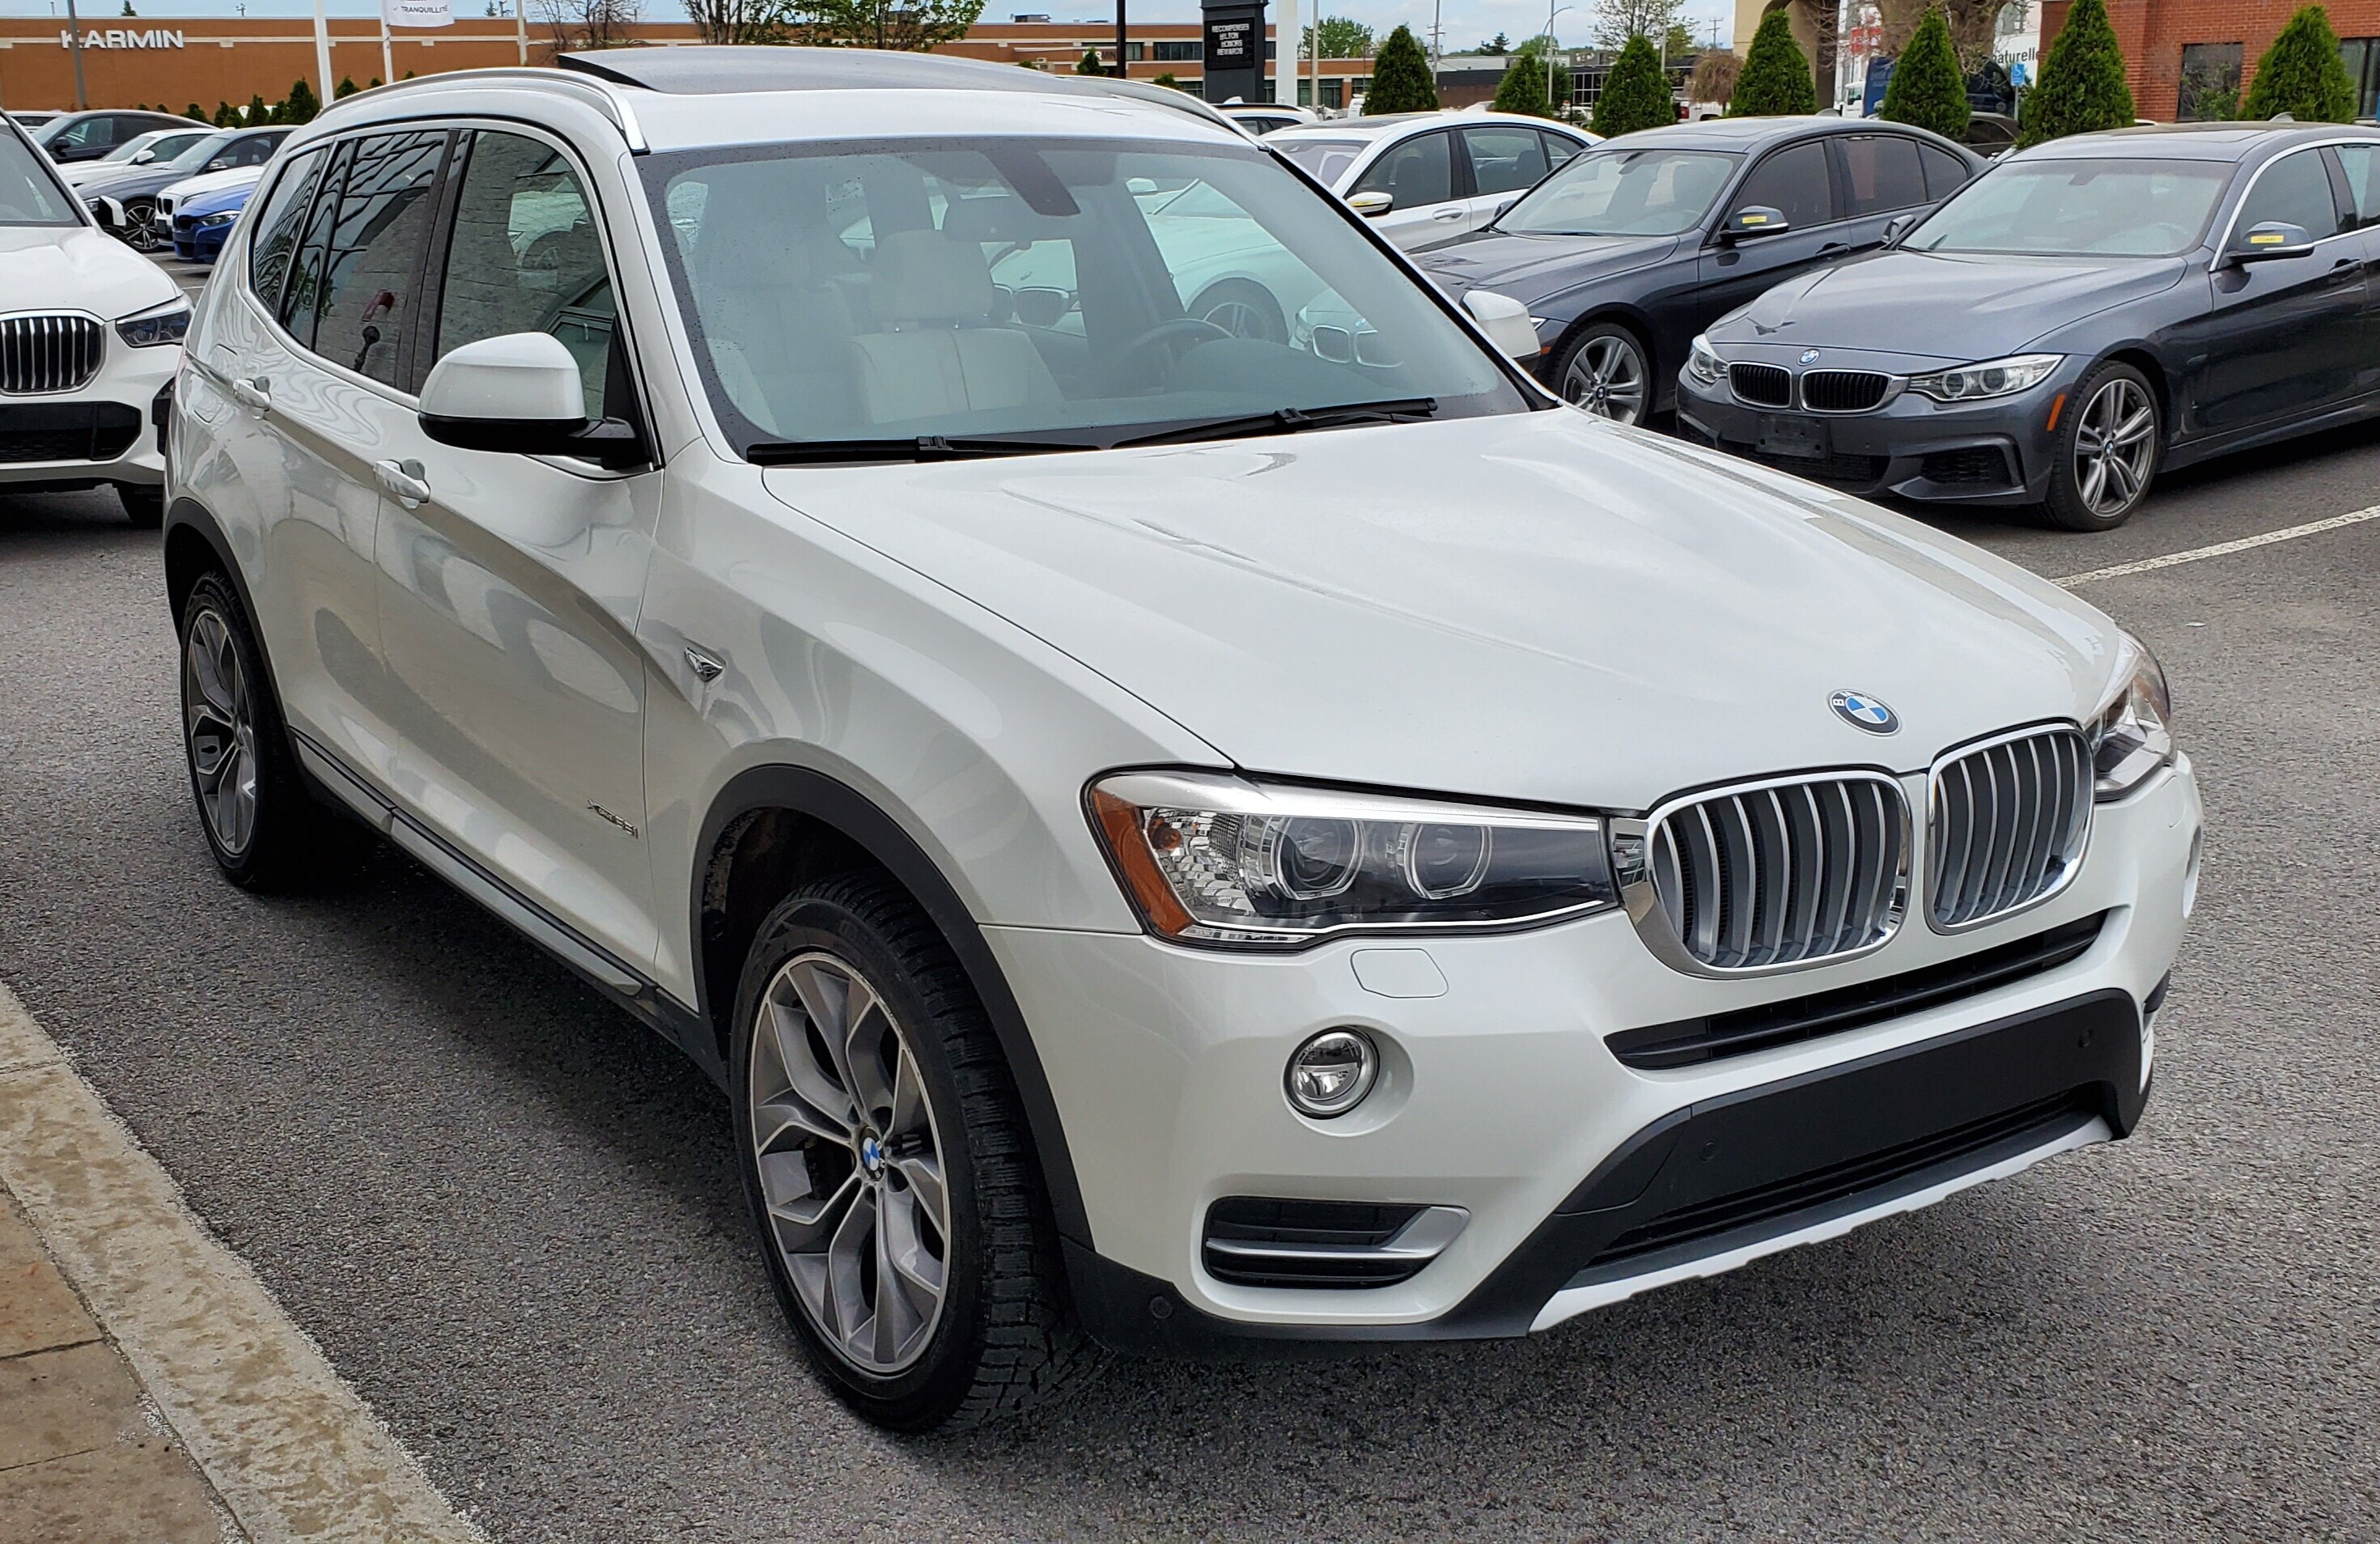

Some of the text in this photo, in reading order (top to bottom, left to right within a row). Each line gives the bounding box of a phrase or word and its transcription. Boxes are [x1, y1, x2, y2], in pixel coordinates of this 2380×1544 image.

[61, 30, 184, 49] KARMIN
[1220, 32, 1239, 40] HILTON
[1216, 48, 1243, 56] REWARDS
